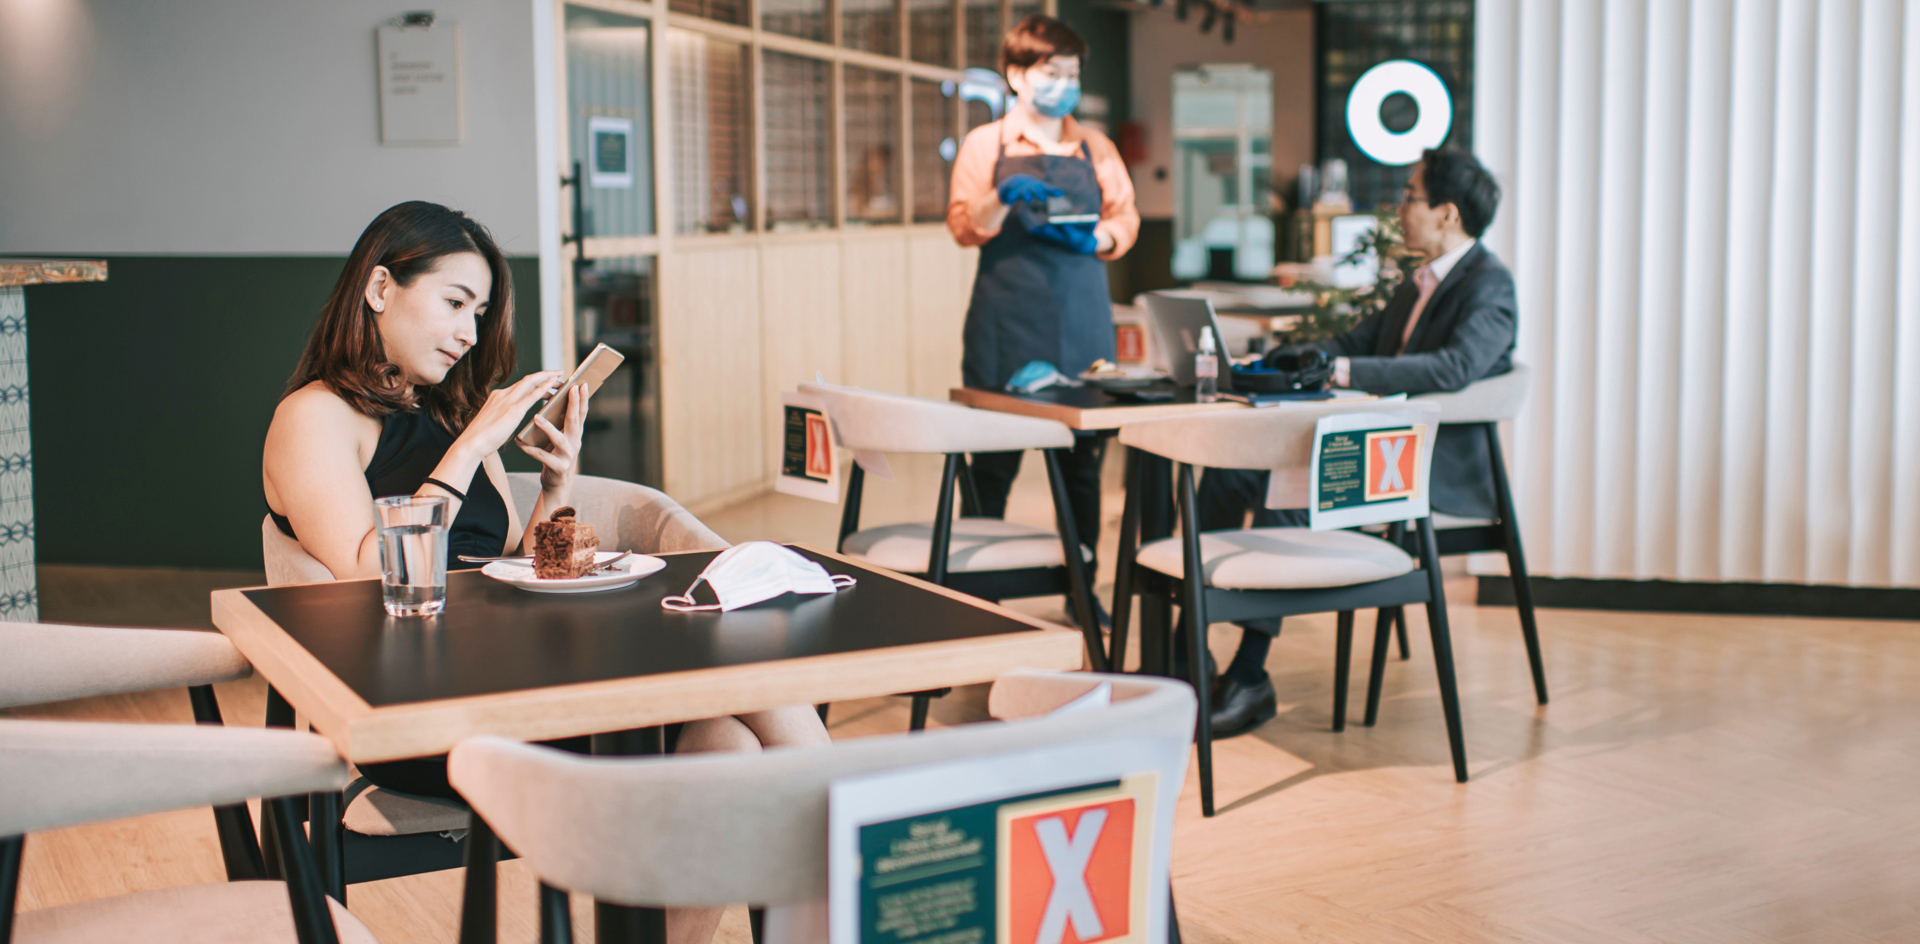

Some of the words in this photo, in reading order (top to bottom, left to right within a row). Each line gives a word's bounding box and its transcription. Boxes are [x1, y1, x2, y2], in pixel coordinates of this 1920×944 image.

[811, 420, 828, 473] X
[1379, 437, 1408, 493] X
[1034, 807, 1110, 944] X
